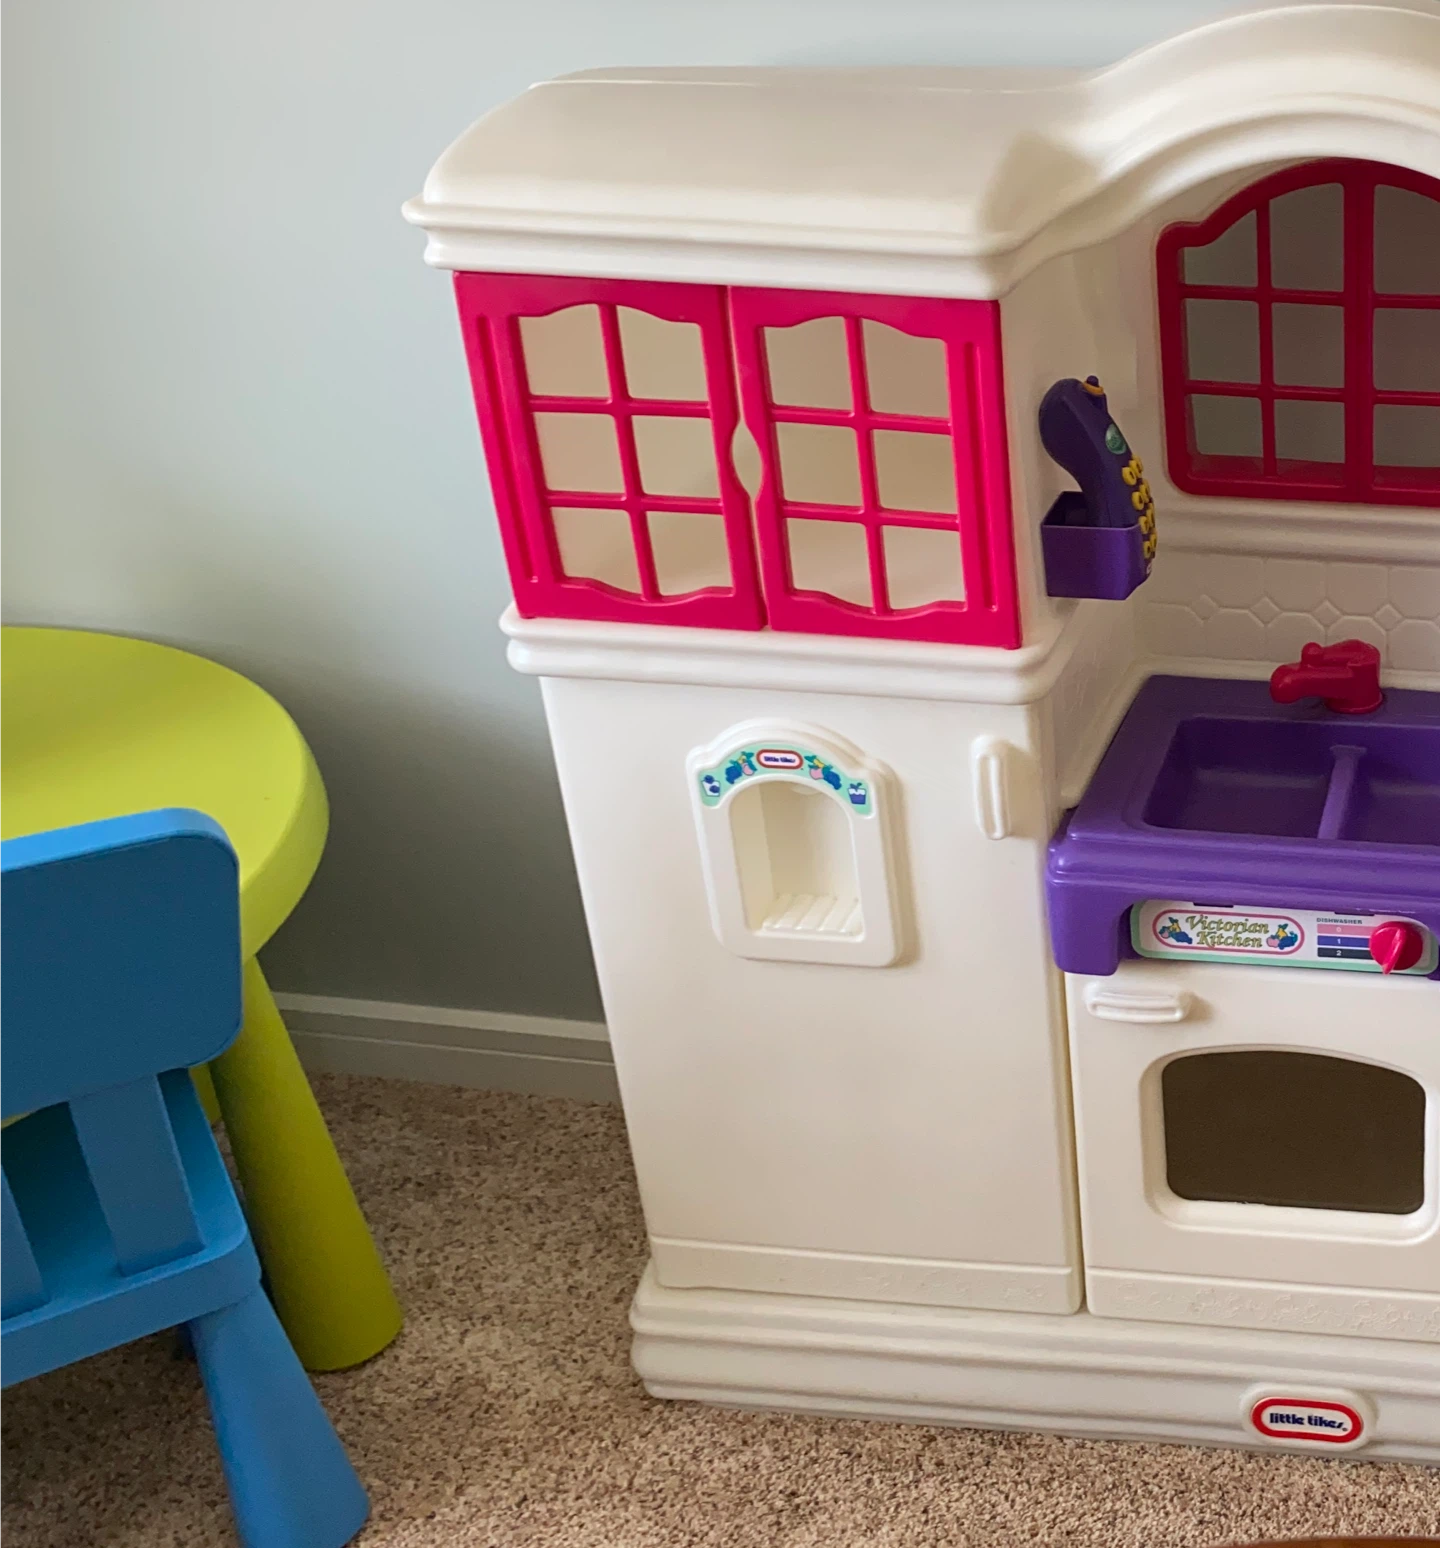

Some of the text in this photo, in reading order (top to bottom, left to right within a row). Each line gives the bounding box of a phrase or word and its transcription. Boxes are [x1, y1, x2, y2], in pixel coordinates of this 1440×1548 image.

[1185, 914, 1270, 935] Victorian
[1316, 917, 1363, 925] DISHWASHER
[1196, 930, 1263, 949] Kitchen
[1269, 1412, 1345, 1429] little tikes
